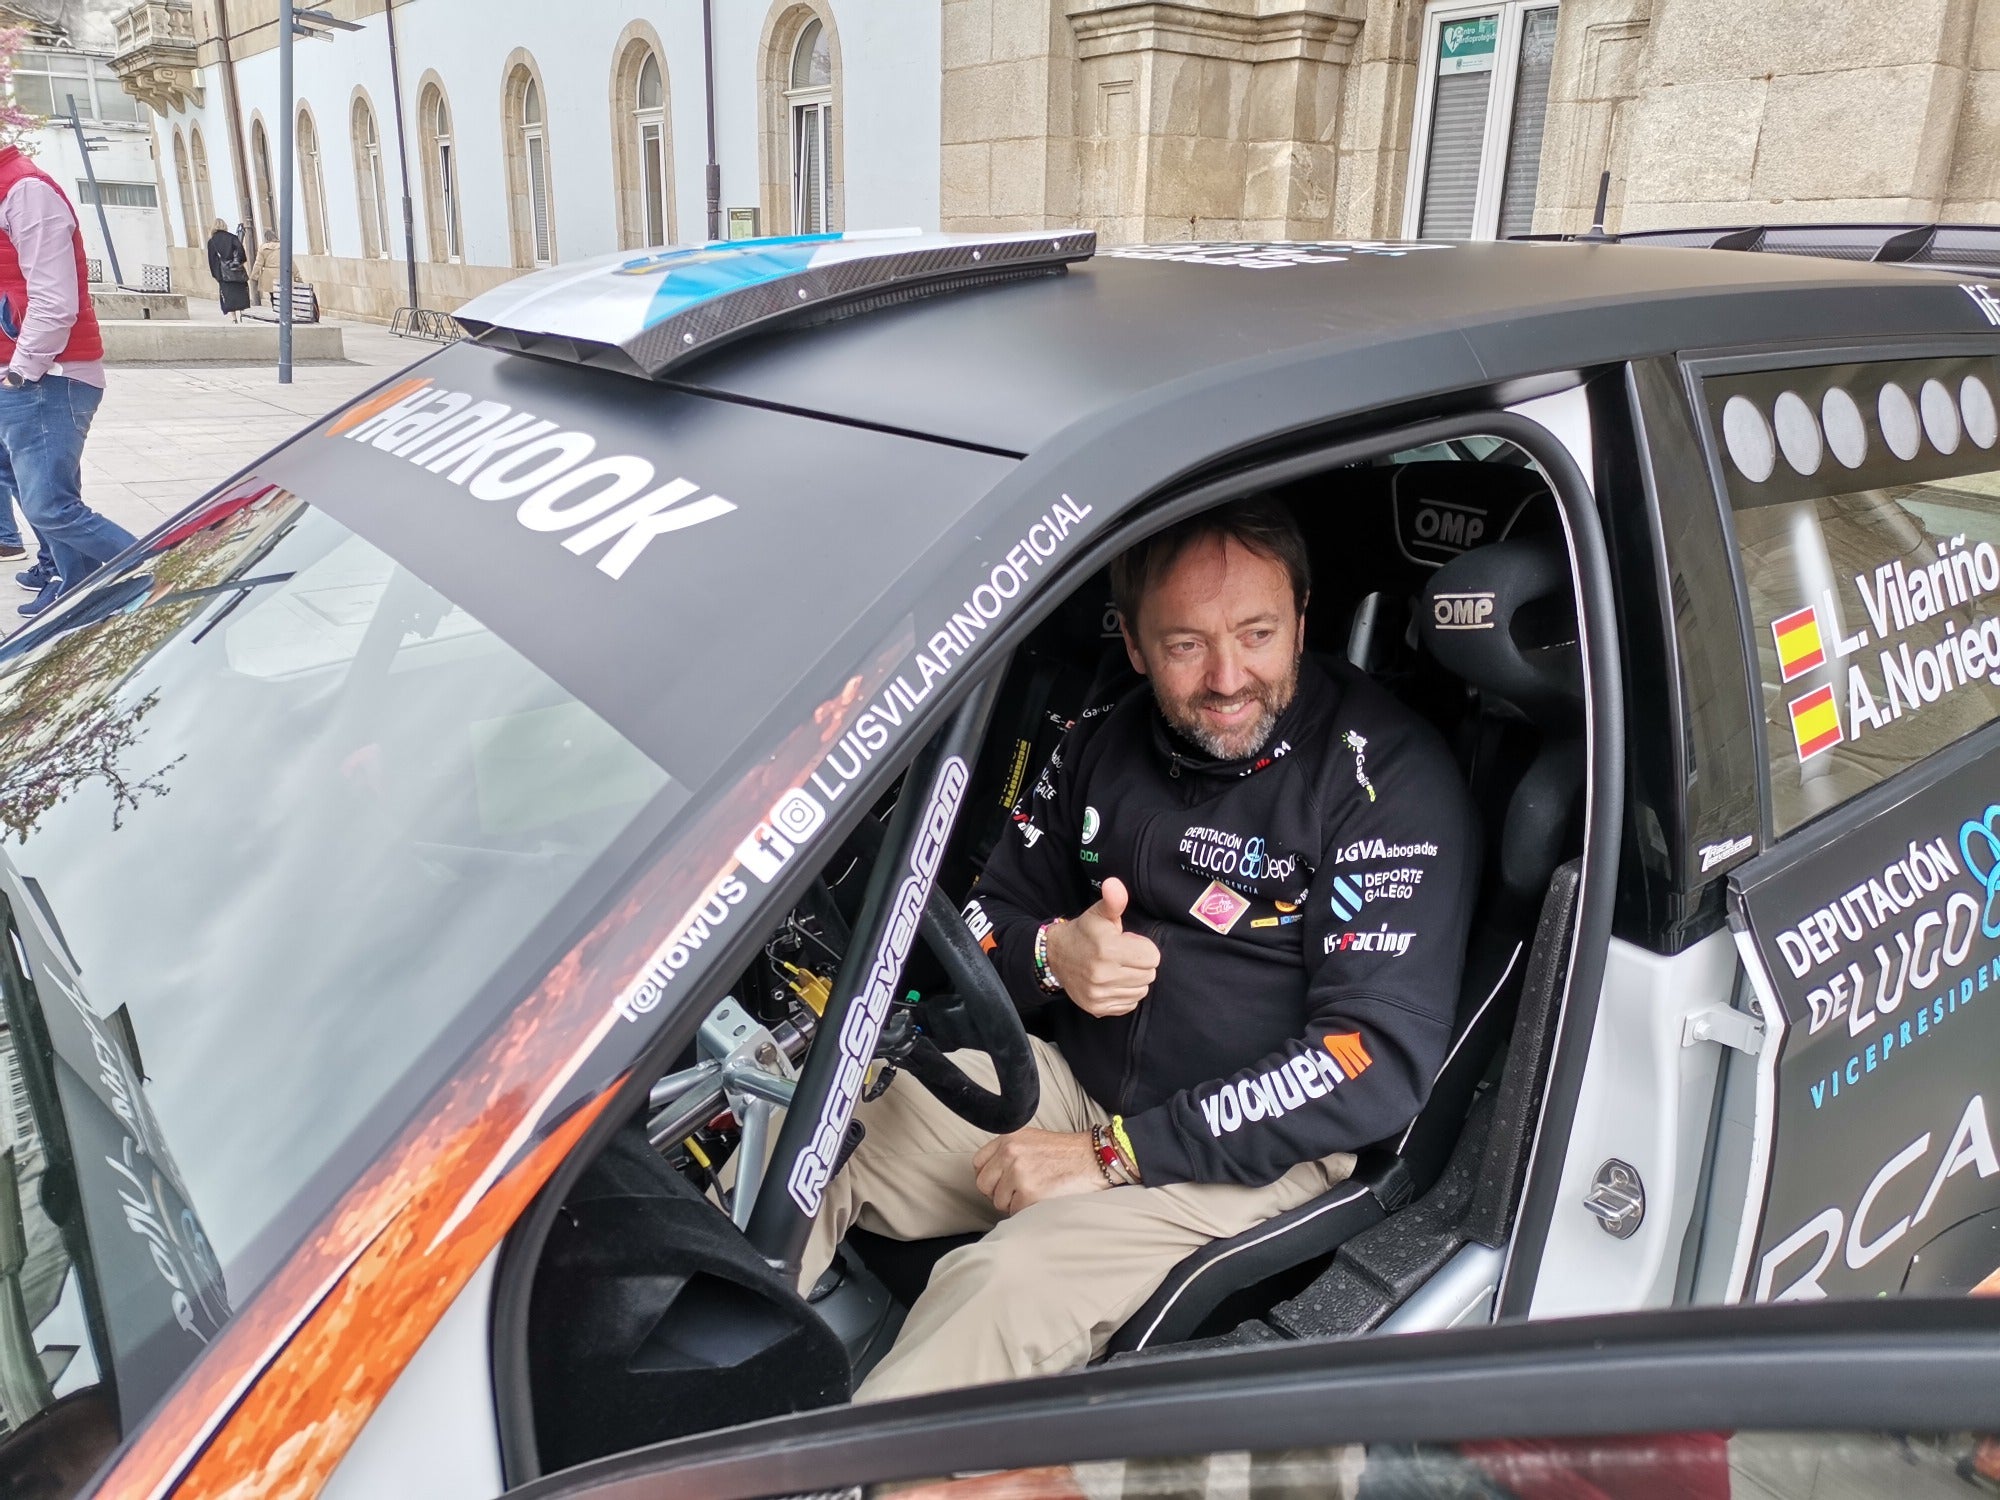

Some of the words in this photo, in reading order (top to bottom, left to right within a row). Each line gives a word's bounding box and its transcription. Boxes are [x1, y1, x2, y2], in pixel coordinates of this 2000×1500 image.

[1415, 508, 1484, 547] OMP
[1434, 598, 1494, 625] OMP
[810, 493, 1093, 802] LUISVILARINOOFICIAL
[1185, 827, 1243, 850] DEPUTACIÓN
[1179, 839, 1193, 853] DE
[1190, 841, 1238, 875] LUGO
[1364, 868, 1424, 888] DEPORTE
[1364, 884, 1413, 903] GALEGO
[1775, 837, 1960, 979] DEPUTACIÓN
[1806, 973, 1849, 1036] DE
[1847, 892, 1980, 1038] LUGO
